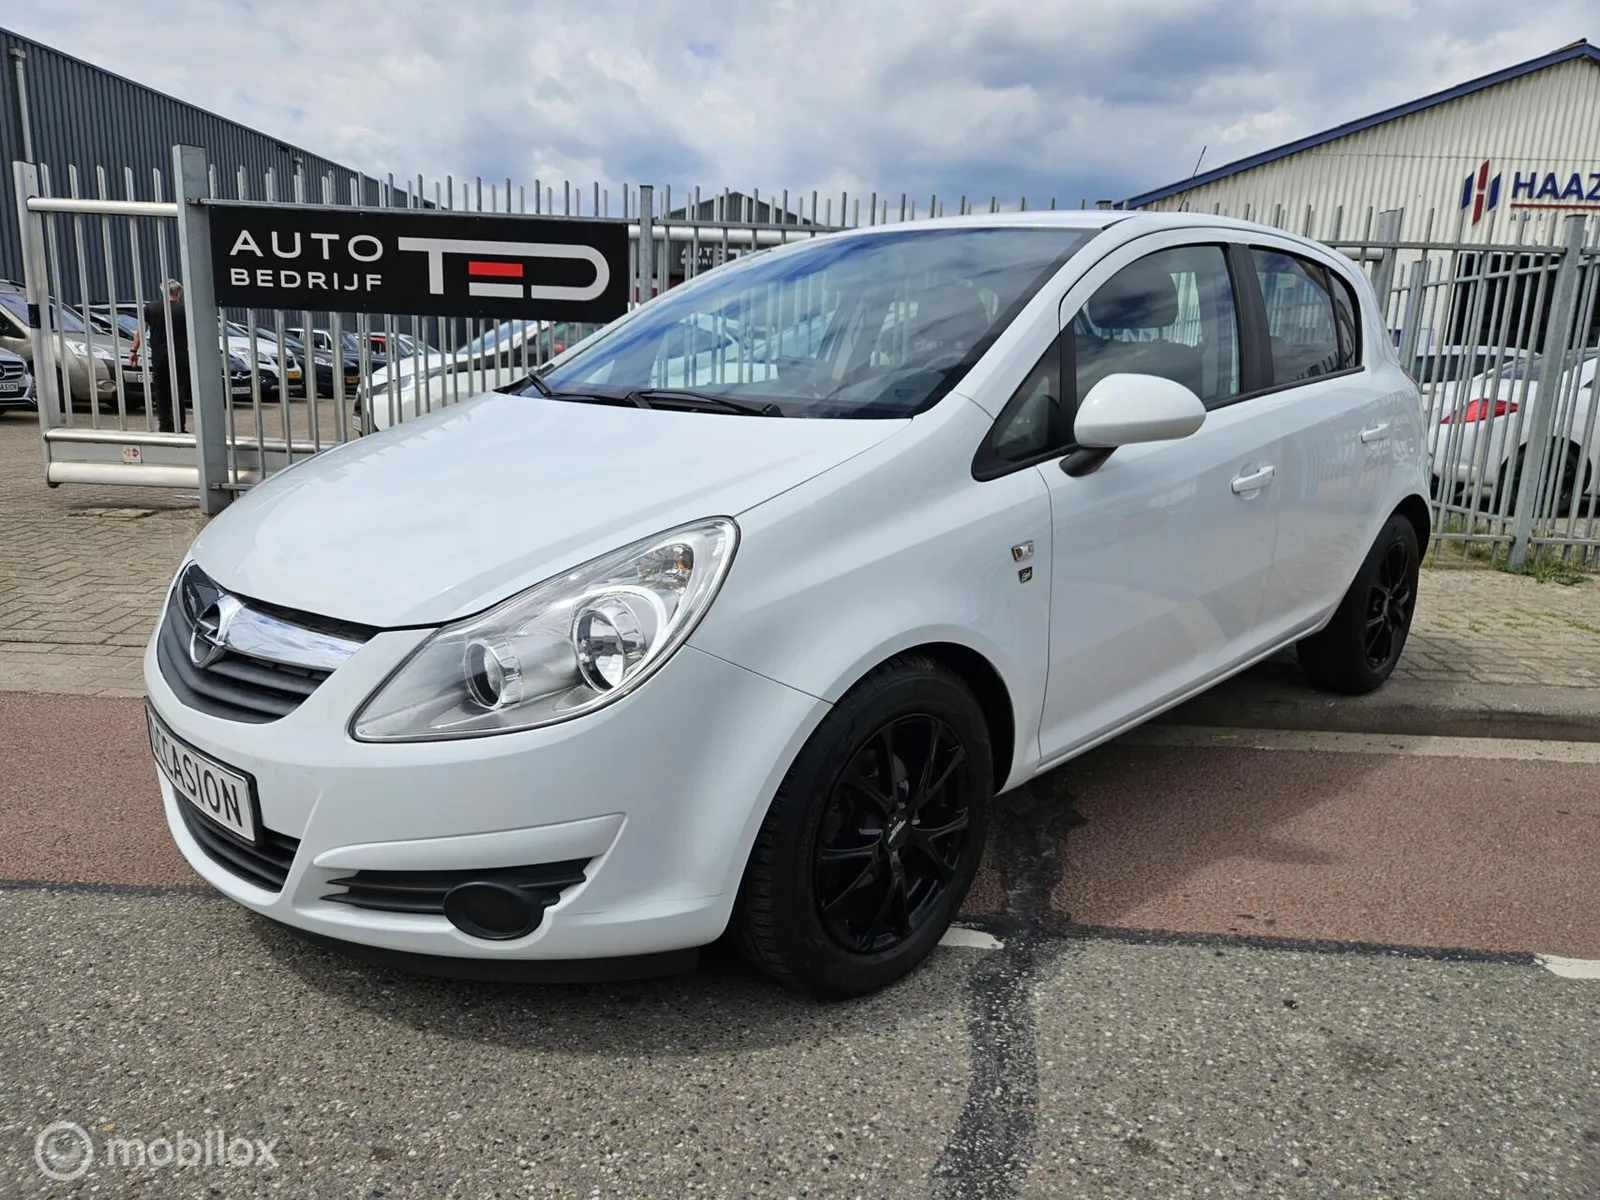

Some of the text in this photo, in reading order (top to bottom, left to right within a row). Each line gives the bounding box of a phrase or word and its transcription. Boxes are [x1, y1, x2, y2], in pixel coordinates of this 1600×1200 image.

[229, 229, 384, 262] AUTO
[230, 267, 383, 292] BEDRIJF
[398, 236, 611, 301] TED
